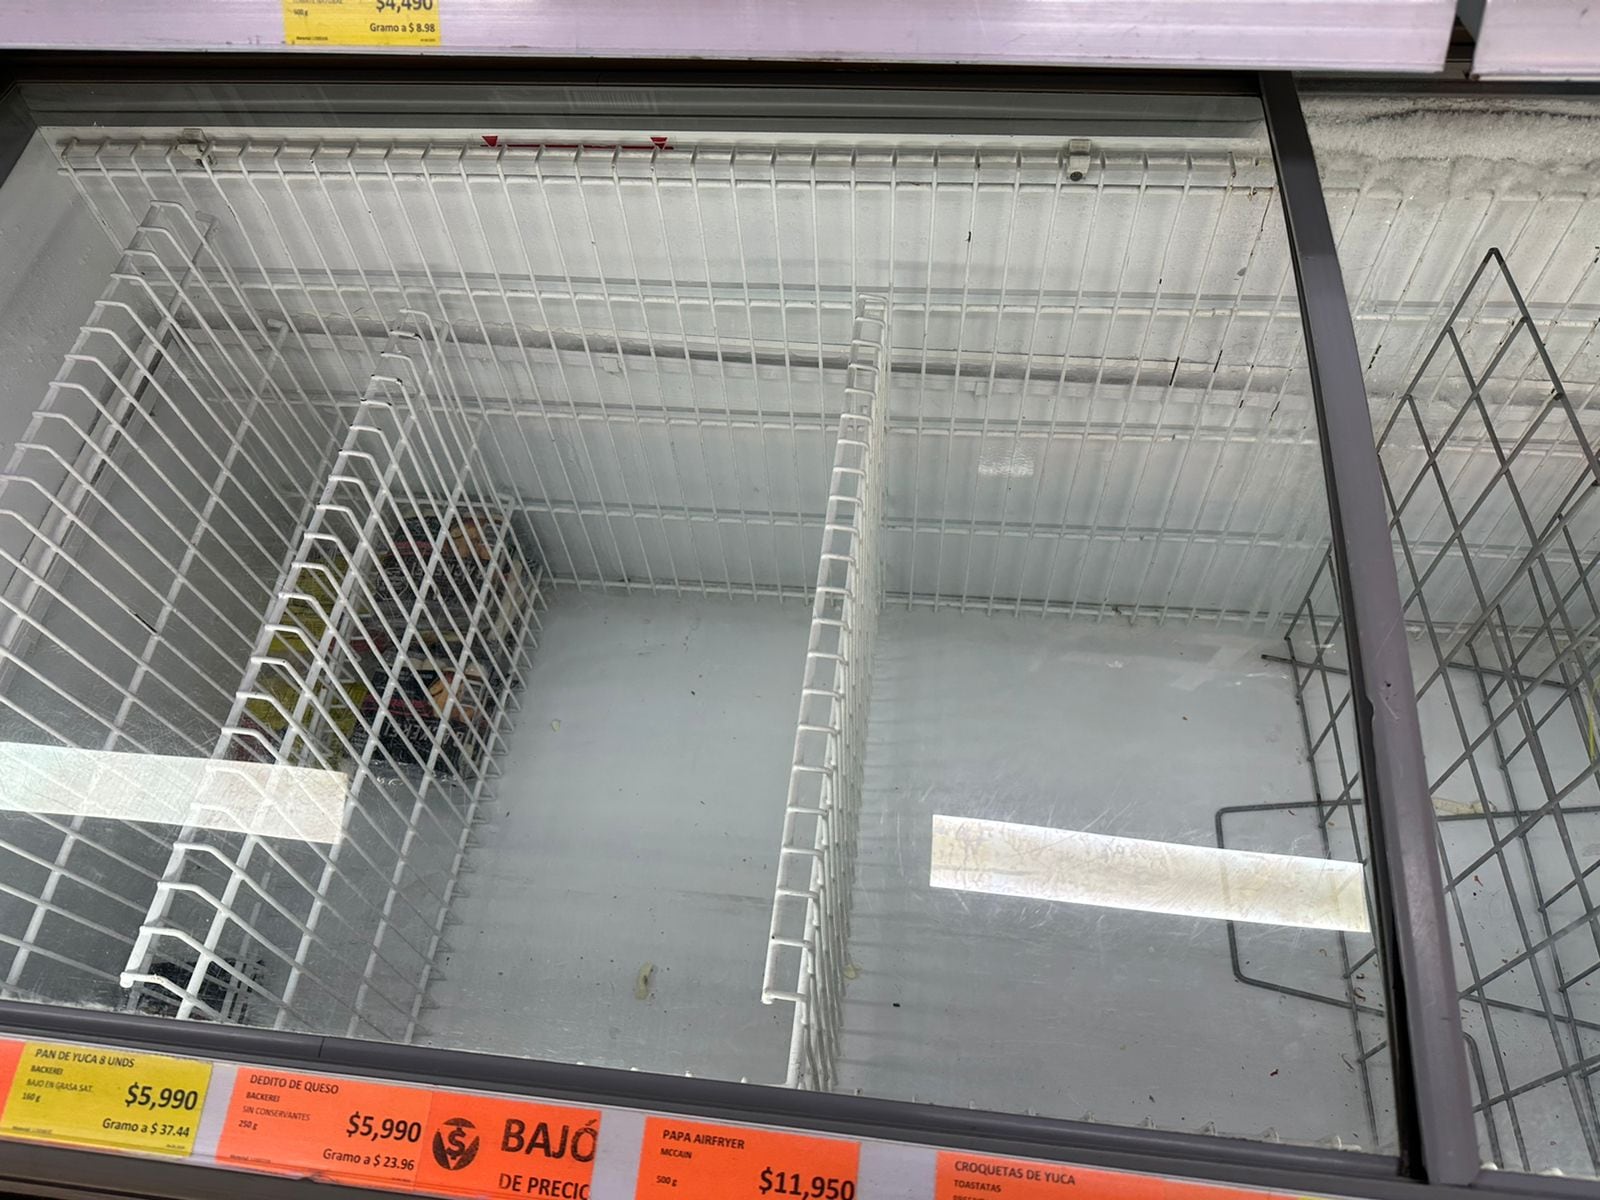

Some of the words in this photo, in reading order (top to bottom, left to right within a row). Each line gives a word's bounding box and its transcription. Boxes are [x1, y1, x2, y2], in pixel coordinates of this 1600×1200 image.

[369, 22, 399, 32] Gramo
[408, 22, 415, 34] $
[416, 23, 435, 32] 8.98
[35, 1048, 56, 1059] PAN
[57, 1051, 71, 1061] DE
[73, 1052, 97, 1064] YUCA
[98, 1055, 106, 1065] 8
[107, 1056, 135, 1068] UNDS
[250, 1074, 287, 1088] DEDITO
[288, 1079, 302, 1090] DE
[304, 1081, 339, 1094] QUESO
[125, 1082, 198, 1110] $5,990
[246, 1092, 280, 1102] BACKEREI
[242, 1105, 254, 1114] SIN
[255, 1107, 311, 1121] CONSERVANTES
[102, 1118, 139, 1132] Gramo
[140, 1125, 148, 1133] a
[150, 1122, 158, 1135] $
[159, 1124, 190, 1137] 37.44
[239, 1120, 252, 1128] 250
[346, 1111, 422, 1143] $5,990
[501, 1118, 598, 1163] BAJÓ
[662, 1129, 691, 1143] PAPA
[693, 1134, 745, 1149] AIRFRYER
[323, 1148, 361, 1164] Gramo
[363, 1156, 371, 1165] a
[373, 1154, 381, 1168] $
[383, 1156, 415, 1171] 23.96
[660, 1148, 692, 1159] MCCAIN
[499, 1173, 523, 1191] DE
[656, 1175, 671, 1185] 500
[954, 1160, 1024, 1179] CROQUETAS
[1026, 1169, 1041, 1181] DE
[1044, 1172, 1076, 1185] YUCA
[759, 1166, 855, 1200] $11,950
[953, 1180, 1001, 1193] TOASTATAS
